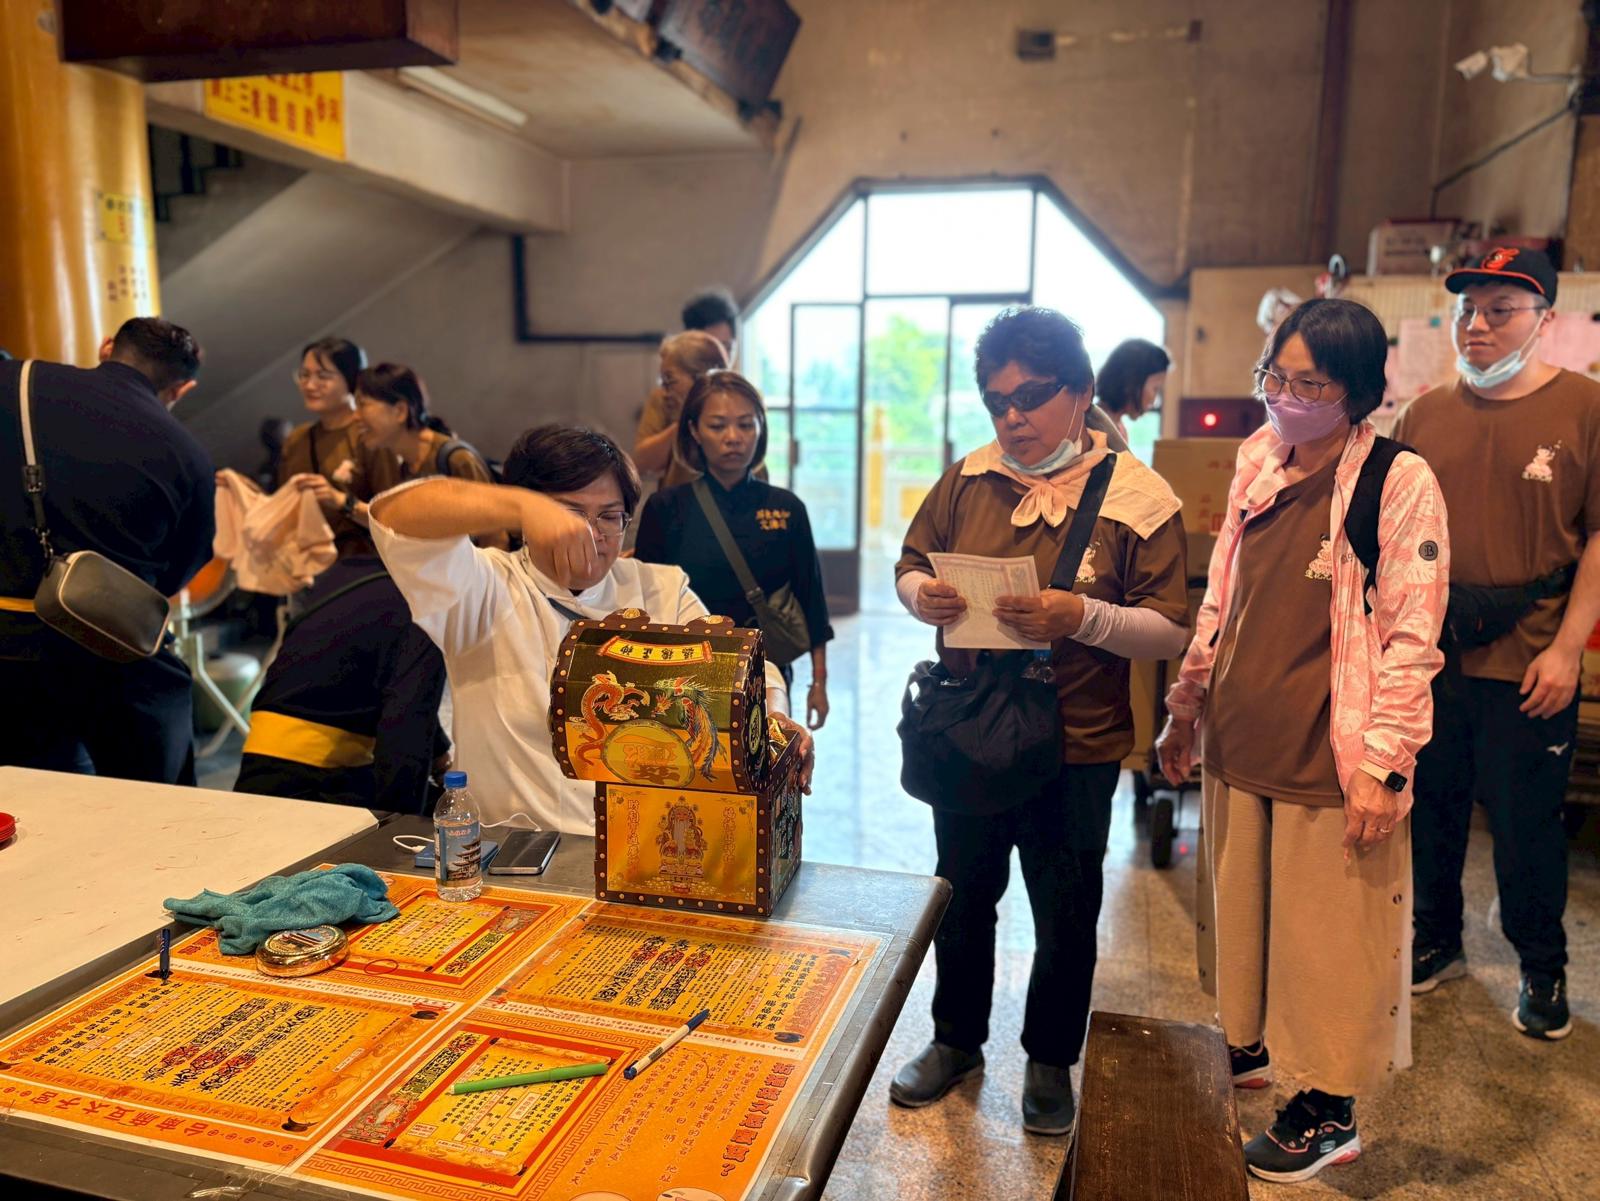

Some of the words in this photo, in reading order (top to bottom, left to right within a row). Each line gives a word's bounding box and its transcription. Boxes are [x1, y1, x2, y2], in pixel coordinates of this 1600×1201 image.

[30, 1090, 210, 1136] 台南麻豆太子宮
